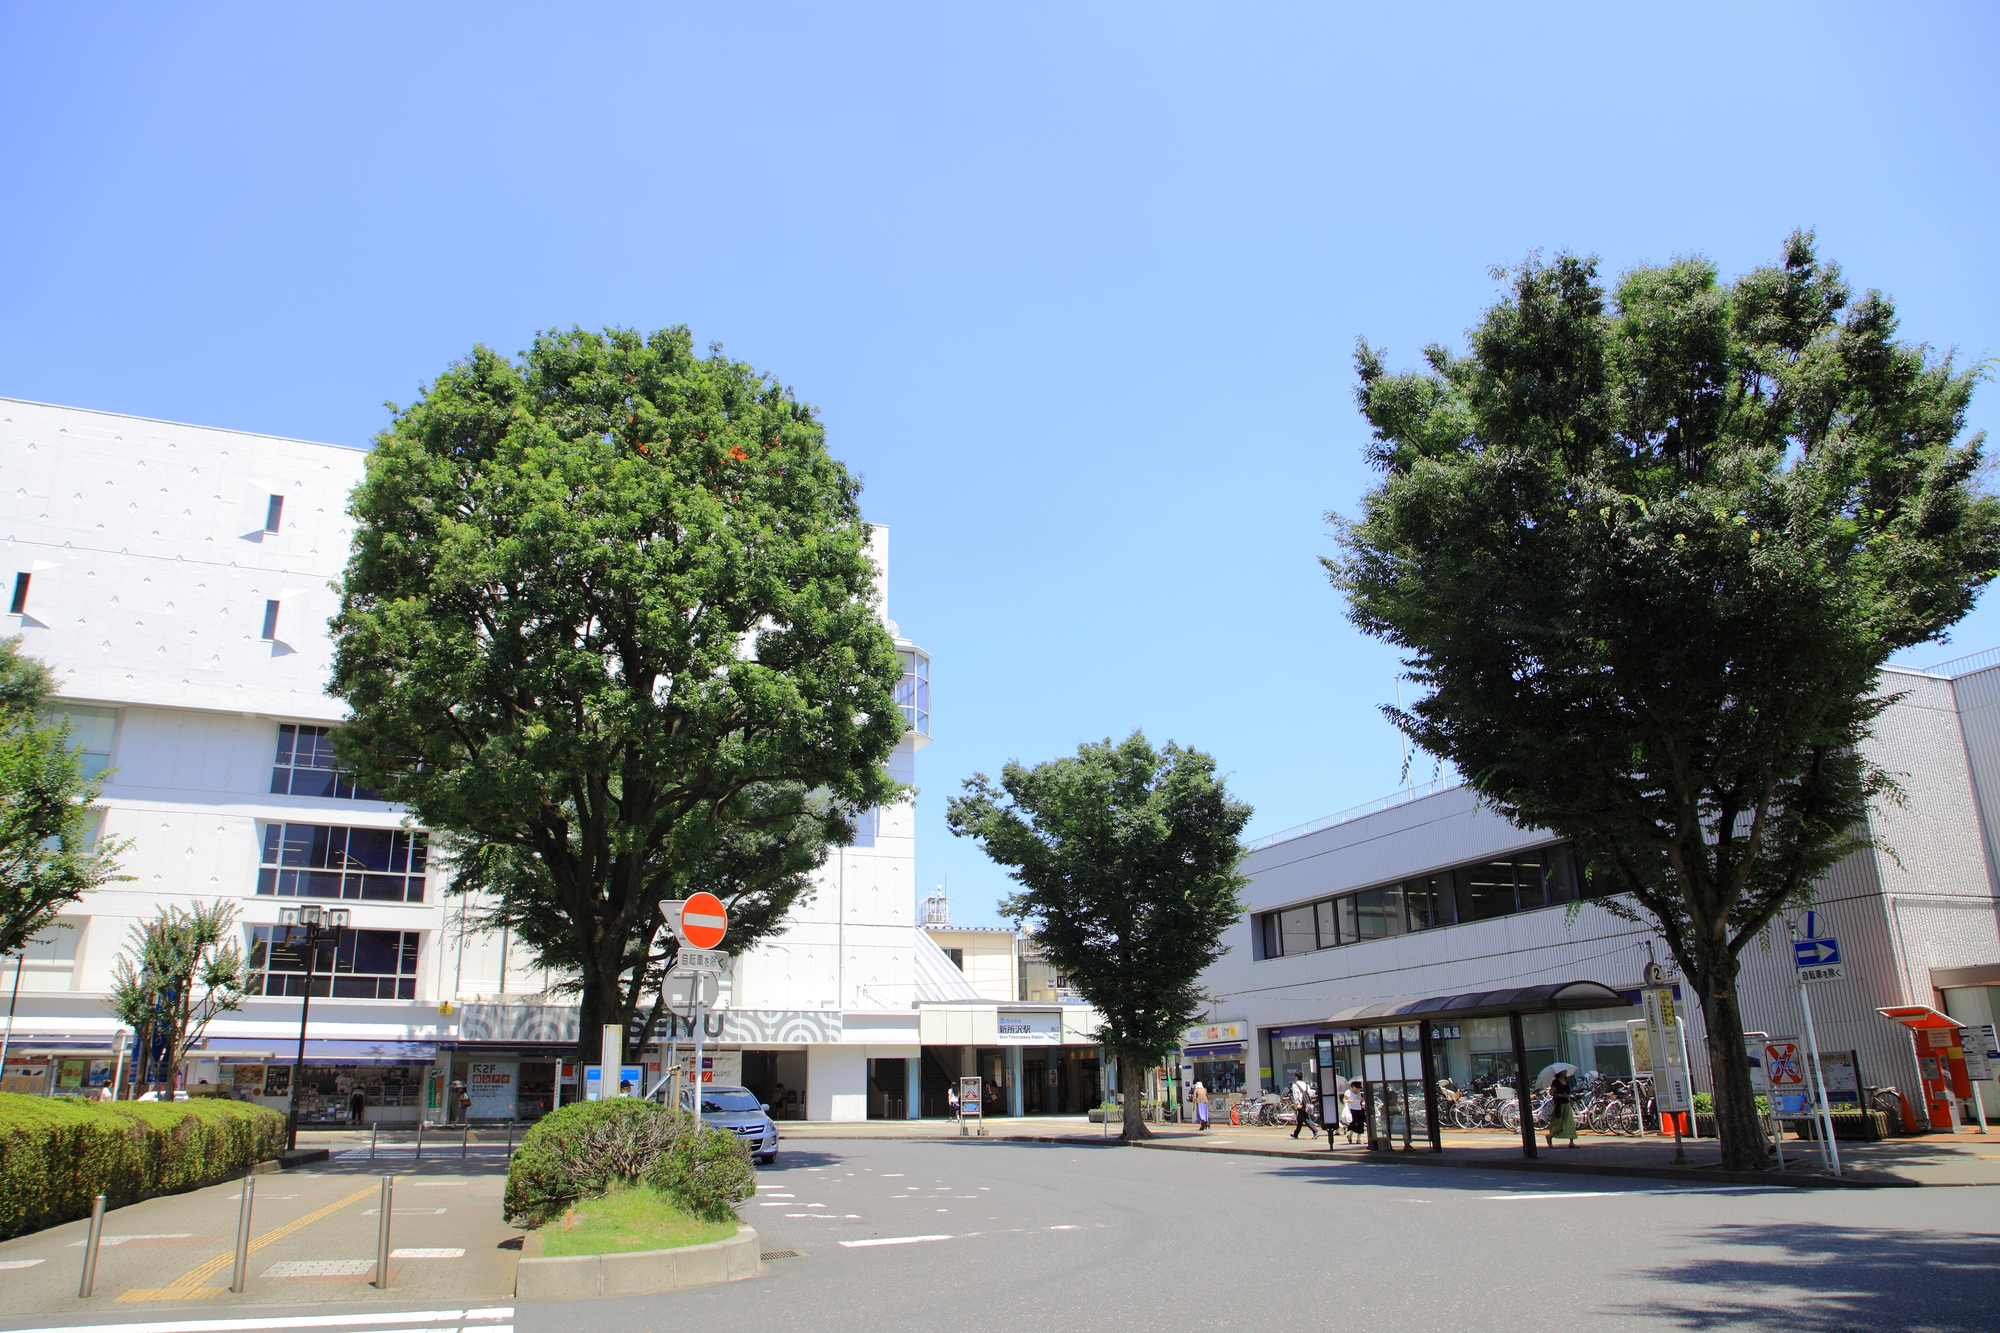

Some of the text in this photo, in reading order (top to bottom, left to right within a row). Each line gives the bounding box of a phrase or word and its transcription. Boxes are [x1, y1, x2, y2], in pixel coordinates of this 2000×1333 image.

[681, 953, 724, 969] 自転車を除く
[1653, 967, 1661, 980] 2
[1801, 967, 1842, 981] 自転車を除く
[999, 1024, 1031, 1034] 新所沢駅
[483, 1064, 496, 1074] 2F
